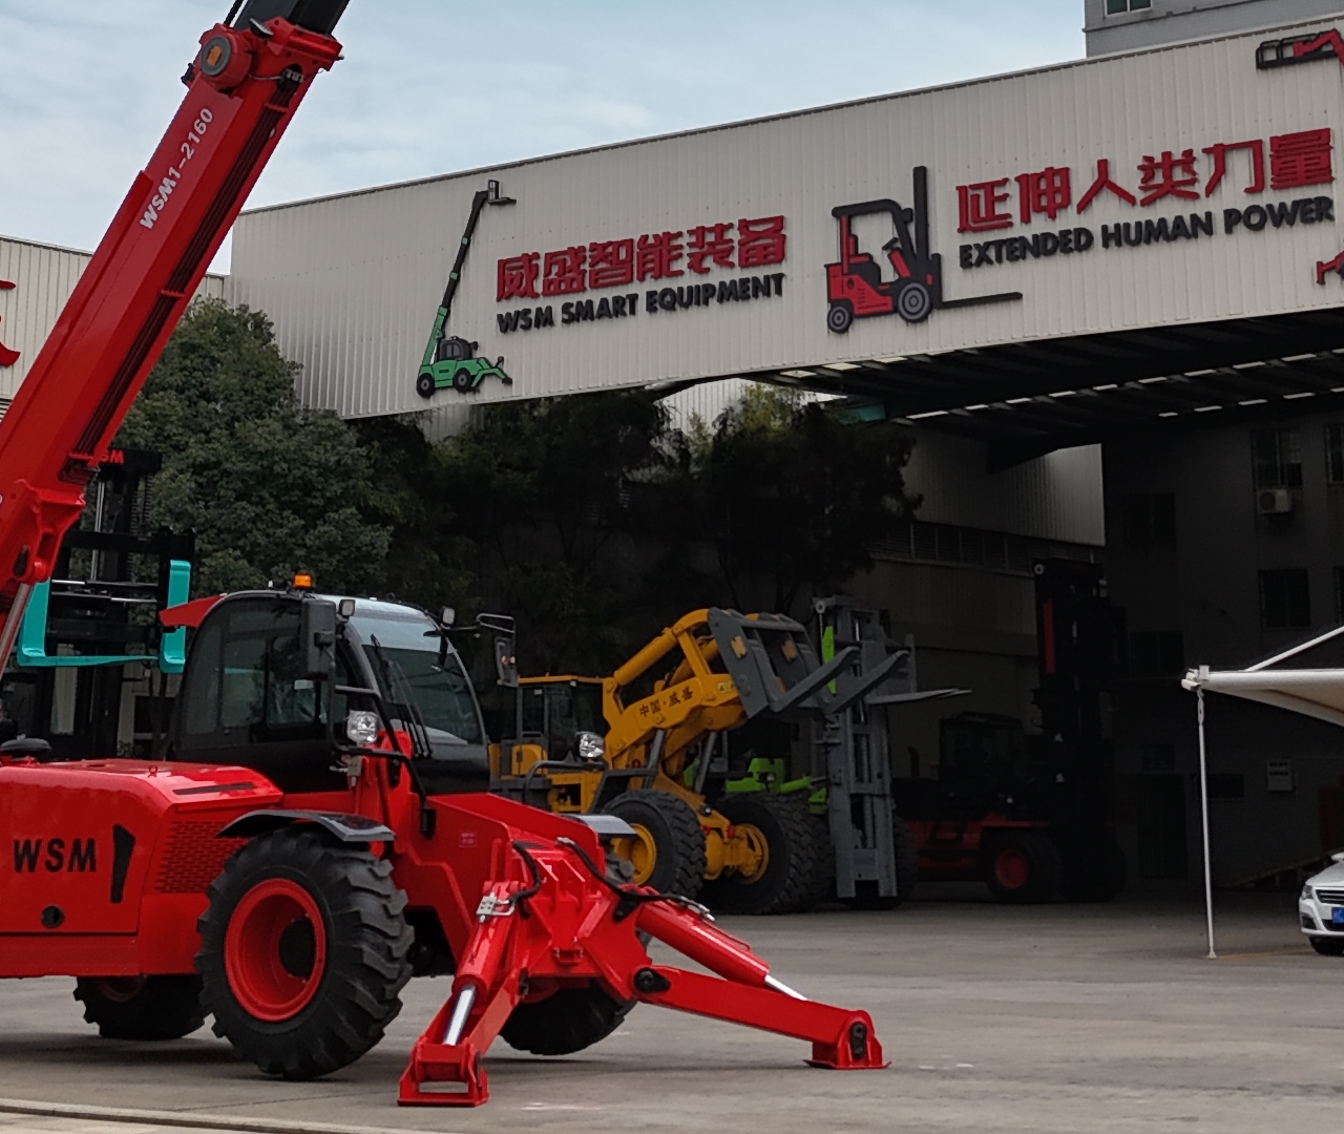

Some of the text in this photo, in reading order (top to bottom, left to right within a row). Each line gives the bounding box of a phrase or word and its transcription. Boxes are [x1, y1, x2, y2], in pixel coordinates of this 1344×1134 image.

[139, 108, 213, 230] WSM1-2160
[956, 127, 1336, 233] 延伸人类力量
[496, 215, 787, 302] 威盛智能装备
[959, 196, 1336, 269] EXTENDED HUMAN POWER
[496, 272, 786, 334] WSM SMART EQUIPMENT
[13, 838, 97, 873] WSM
